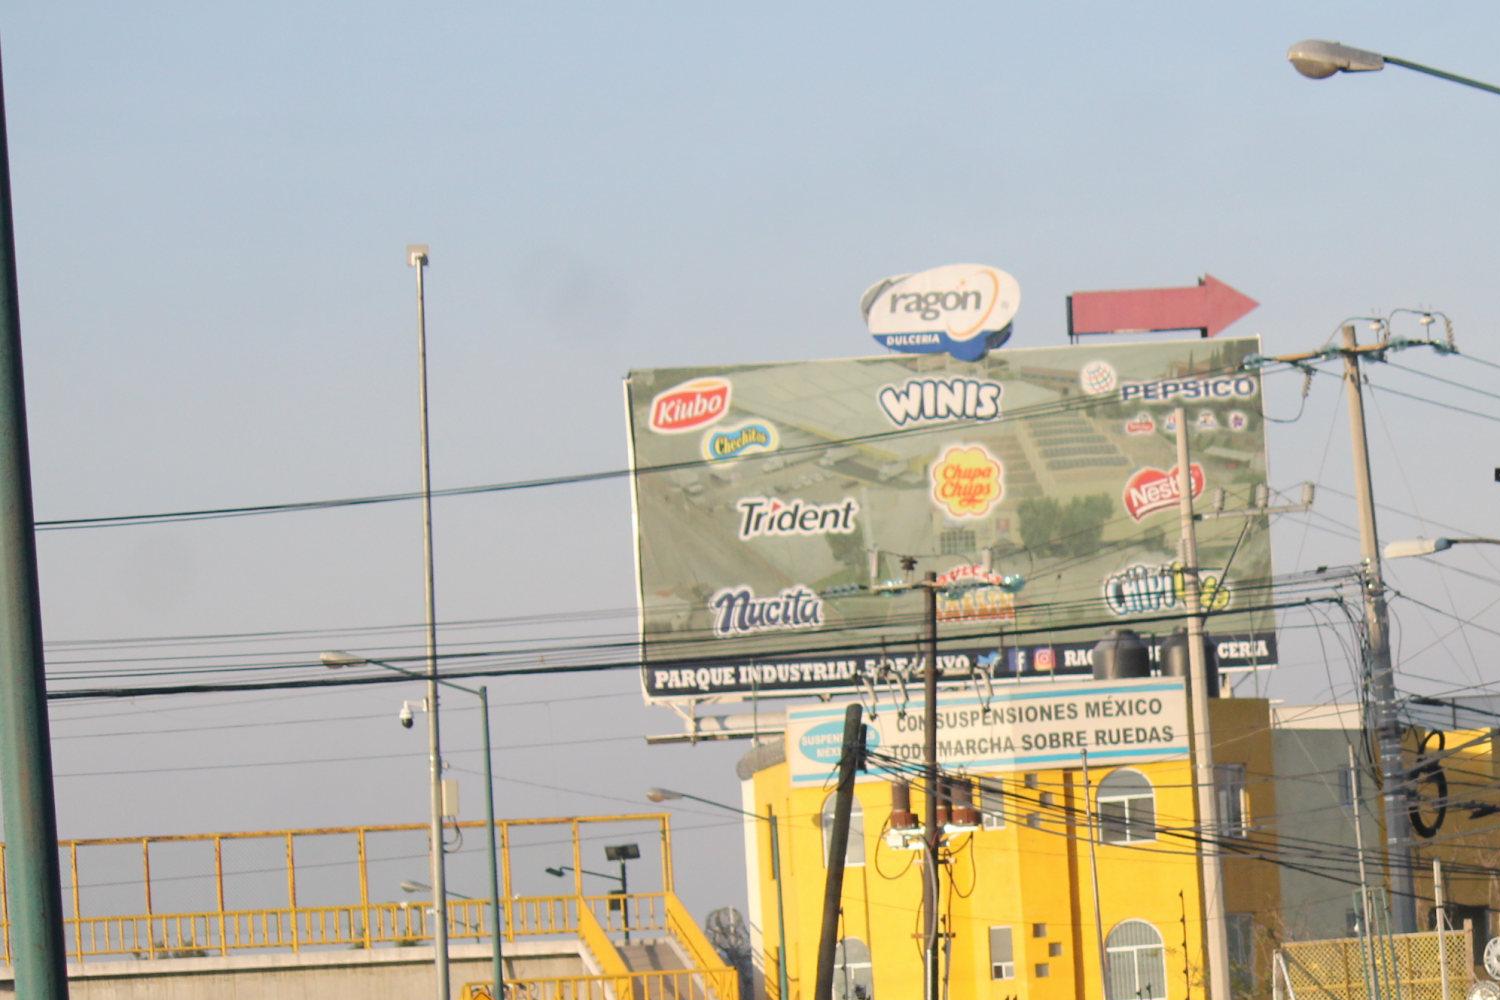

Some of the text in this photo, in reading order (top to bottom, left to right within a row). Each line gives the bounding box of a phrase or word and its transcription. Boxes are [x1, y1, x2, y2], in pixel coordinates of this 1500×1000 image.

[886, 334, 940, 346] DULCERIA
[657, 393, 723, 425] Kiubo
[879, 377, 1002, 427] WINIS
[943, 463, 993, 481] Chupa
[940, 481, 991, 499] Chups
[740, 500, 855, 536] Trident
[715, 588, 822, 632] Nucita
[1217, 640, 1269, 659] CERIA
[654, 666, 737, 691] PARQUE
[738, 658, 861, 685] INDUSTRIAL
[936, 703, 1079, 729] SUSPENSIONES
[1085, 695, 1162, 718] MÉXICO
[938, 736, 1015, 758] MARCHA
[1021, 730, 1088, 751] SOBRE
[1094, 725, 1174, 746] RUEDAS
